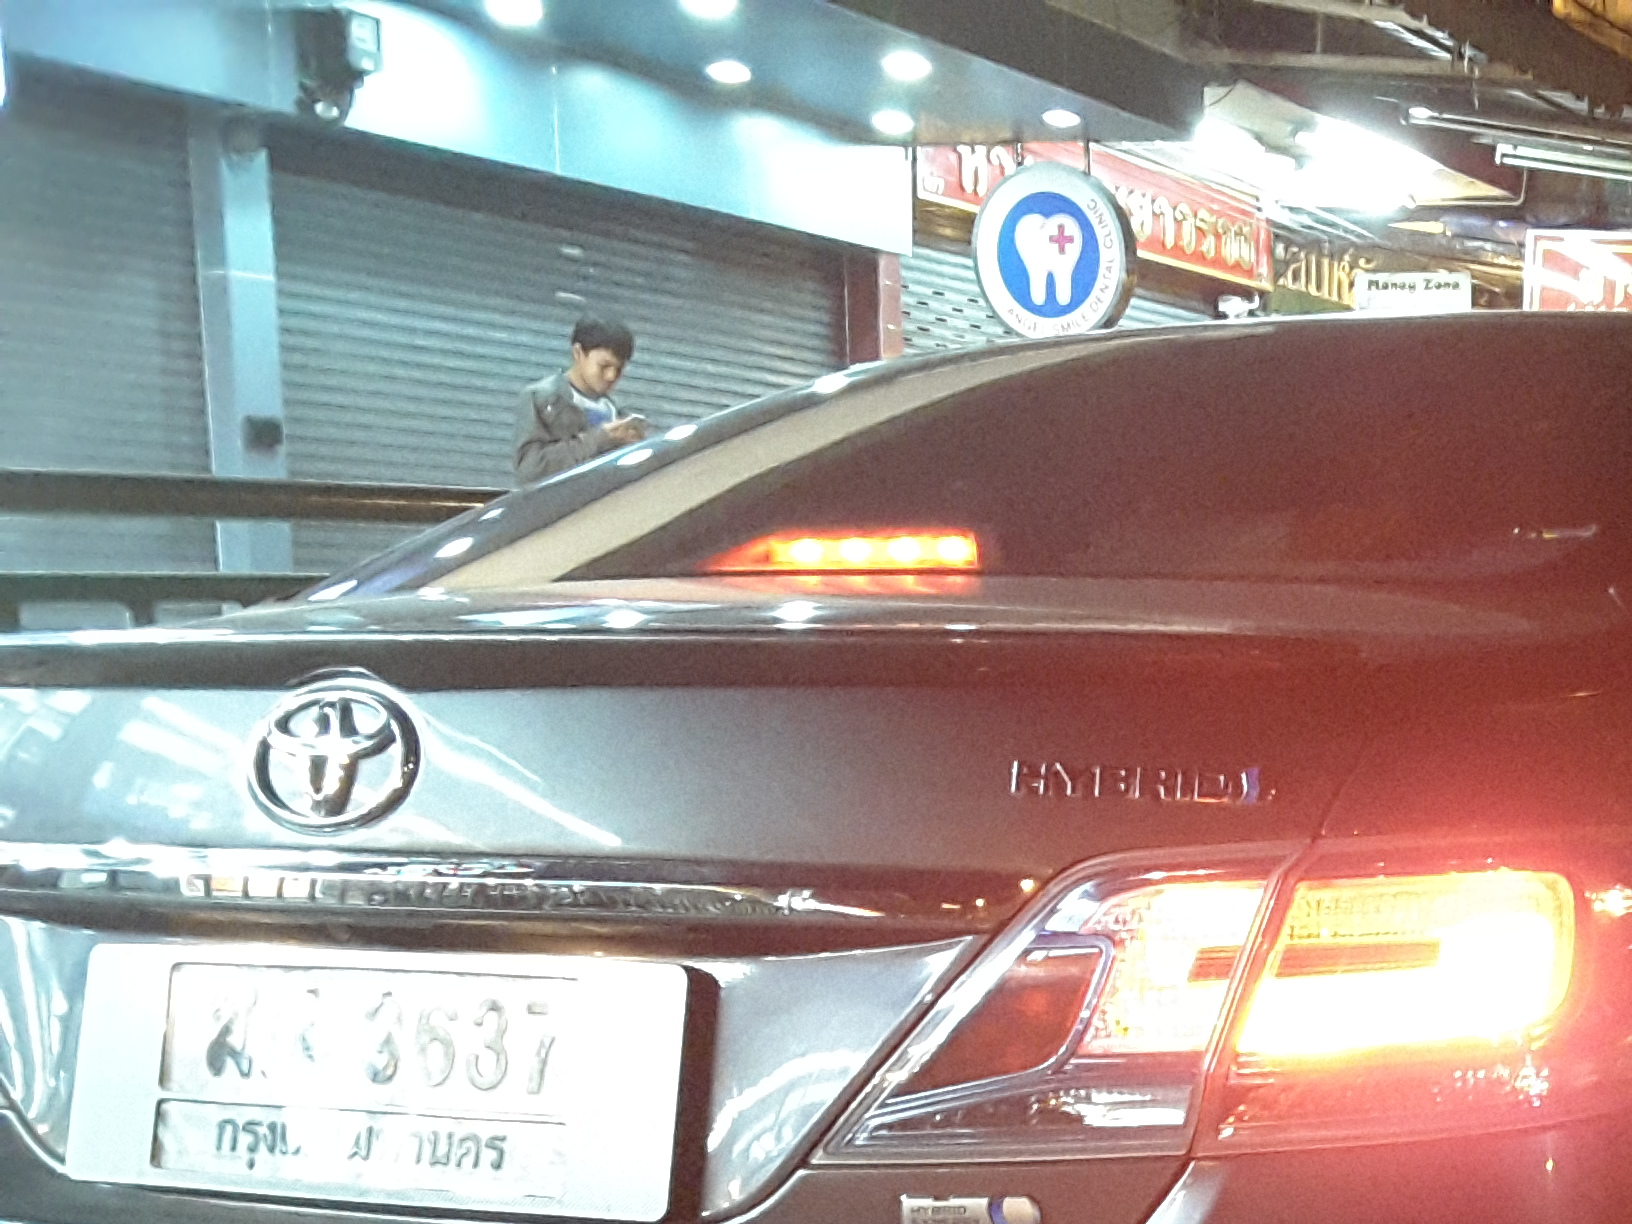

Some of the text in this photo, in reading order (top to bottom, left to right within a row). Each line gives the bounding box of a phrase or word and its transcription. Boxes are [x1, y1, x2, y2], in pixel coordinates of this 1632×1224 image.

[1086, 198, 1114, 250] CLINIC
[1089, 257, 1115, 313] DENTAL
[1009, 759, 1231, 802] HYBRID
